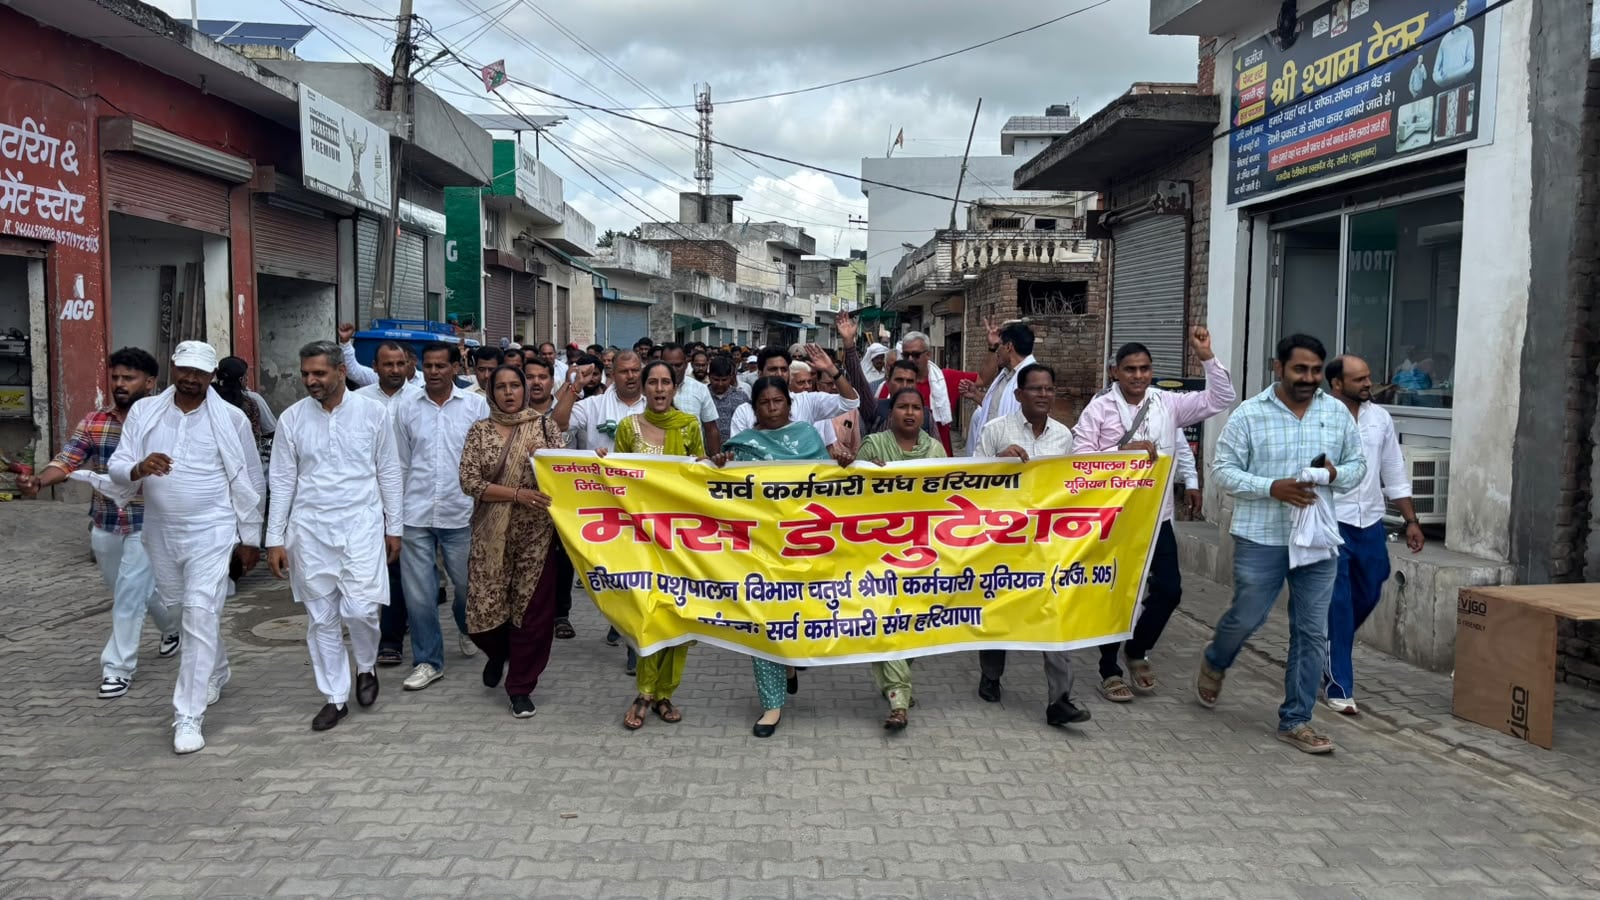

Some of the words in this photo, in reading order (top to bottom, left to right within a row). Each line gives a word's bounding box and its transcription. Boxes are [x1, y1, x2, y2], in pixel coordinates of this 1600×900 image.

[1270, 60, 1298, 106] श्री
[1302, 40, 1363, 94] श्याम
[1367, 11, 1430, 66] टेलर
[1308, 116, 1325, 132] सोफा
[1327, 110, 1343, 124] कवर
[1366, 93, 1382, 111] जाते
[0, 116, 60, 168] टरिंग
[61, 140, 80, 176] &
[311, 137, 341, 162] PREMIUM
[0, 168, 34, 215] मेंट
[35, 180, 86, 224] स्टोर
[60, 299, 95, 321] ACC
[552, 462, 600, 475] कर्मचारी
[605, 466, 646, 479] एकता
[707, 474, 755, 500] सर्व
[762, 473, 866, 500] कर्मचारी
[922, 470, 1021, 492] हरियाणा
[1064, 476, 1107, 495] यूनियन
[1072, 460, 1126, 475] पशुपालन
[577, 506, 758, 551] मास
[779, 494, 1123, 569] डेप्युटेशन
[586, 566, 653, 592] हरियाणा
[657, 573, 738, 606] पशुपालन
[744, 572, 804, 601] विभाग
[808, 571, 852, 610] चतुर्थ
[902, 567, 976, 596] कर्मचारी
[979, 564, 1045, 599] यूनियन
[766, 611, 800, 641] सर्व
[804, 609, 876, 641] कर्मचारी
[882, 608, 912, 635] संघ
[915, 605, 982, 632] हरियाणा
